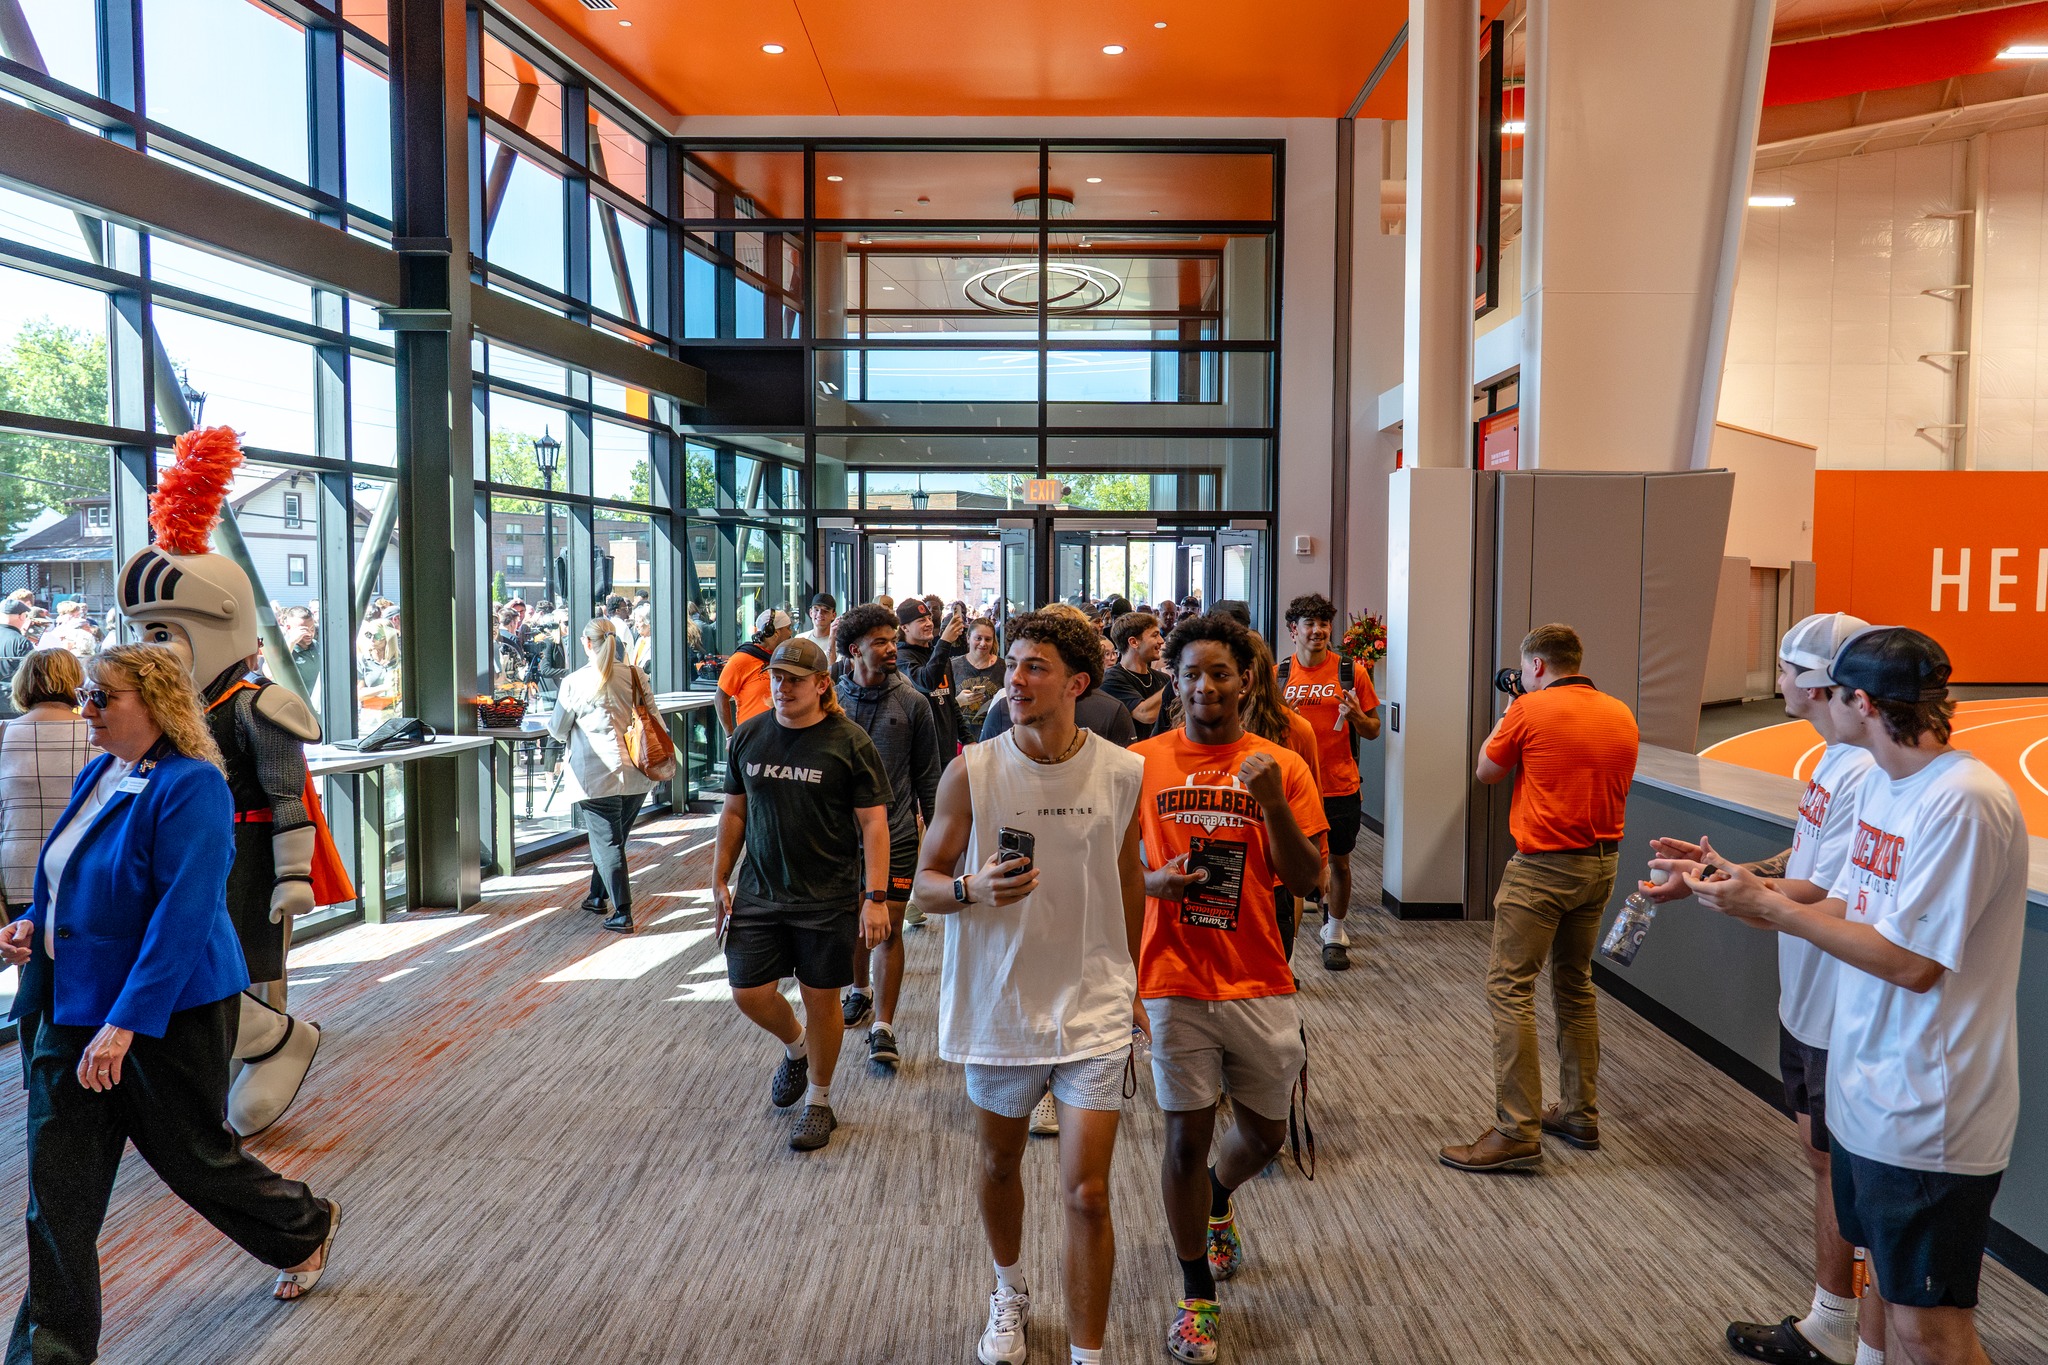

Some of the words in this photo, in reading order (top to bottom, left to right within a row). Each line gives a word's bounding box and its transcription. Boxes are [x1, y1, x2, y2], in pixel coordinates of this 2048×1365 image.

[1030, 480, 1056, 500] EXIT
[1931, 548, 2048, 612] HEI
[1284, 684, 1335, 700] BERG
[763, 764, 823, 783] KANE
[1175, 813, 1244, 828] FOOTBALL
[1185, 904, 1235, 920] Fieldhouse
[1190, 915, 1228, 929] Frann's
